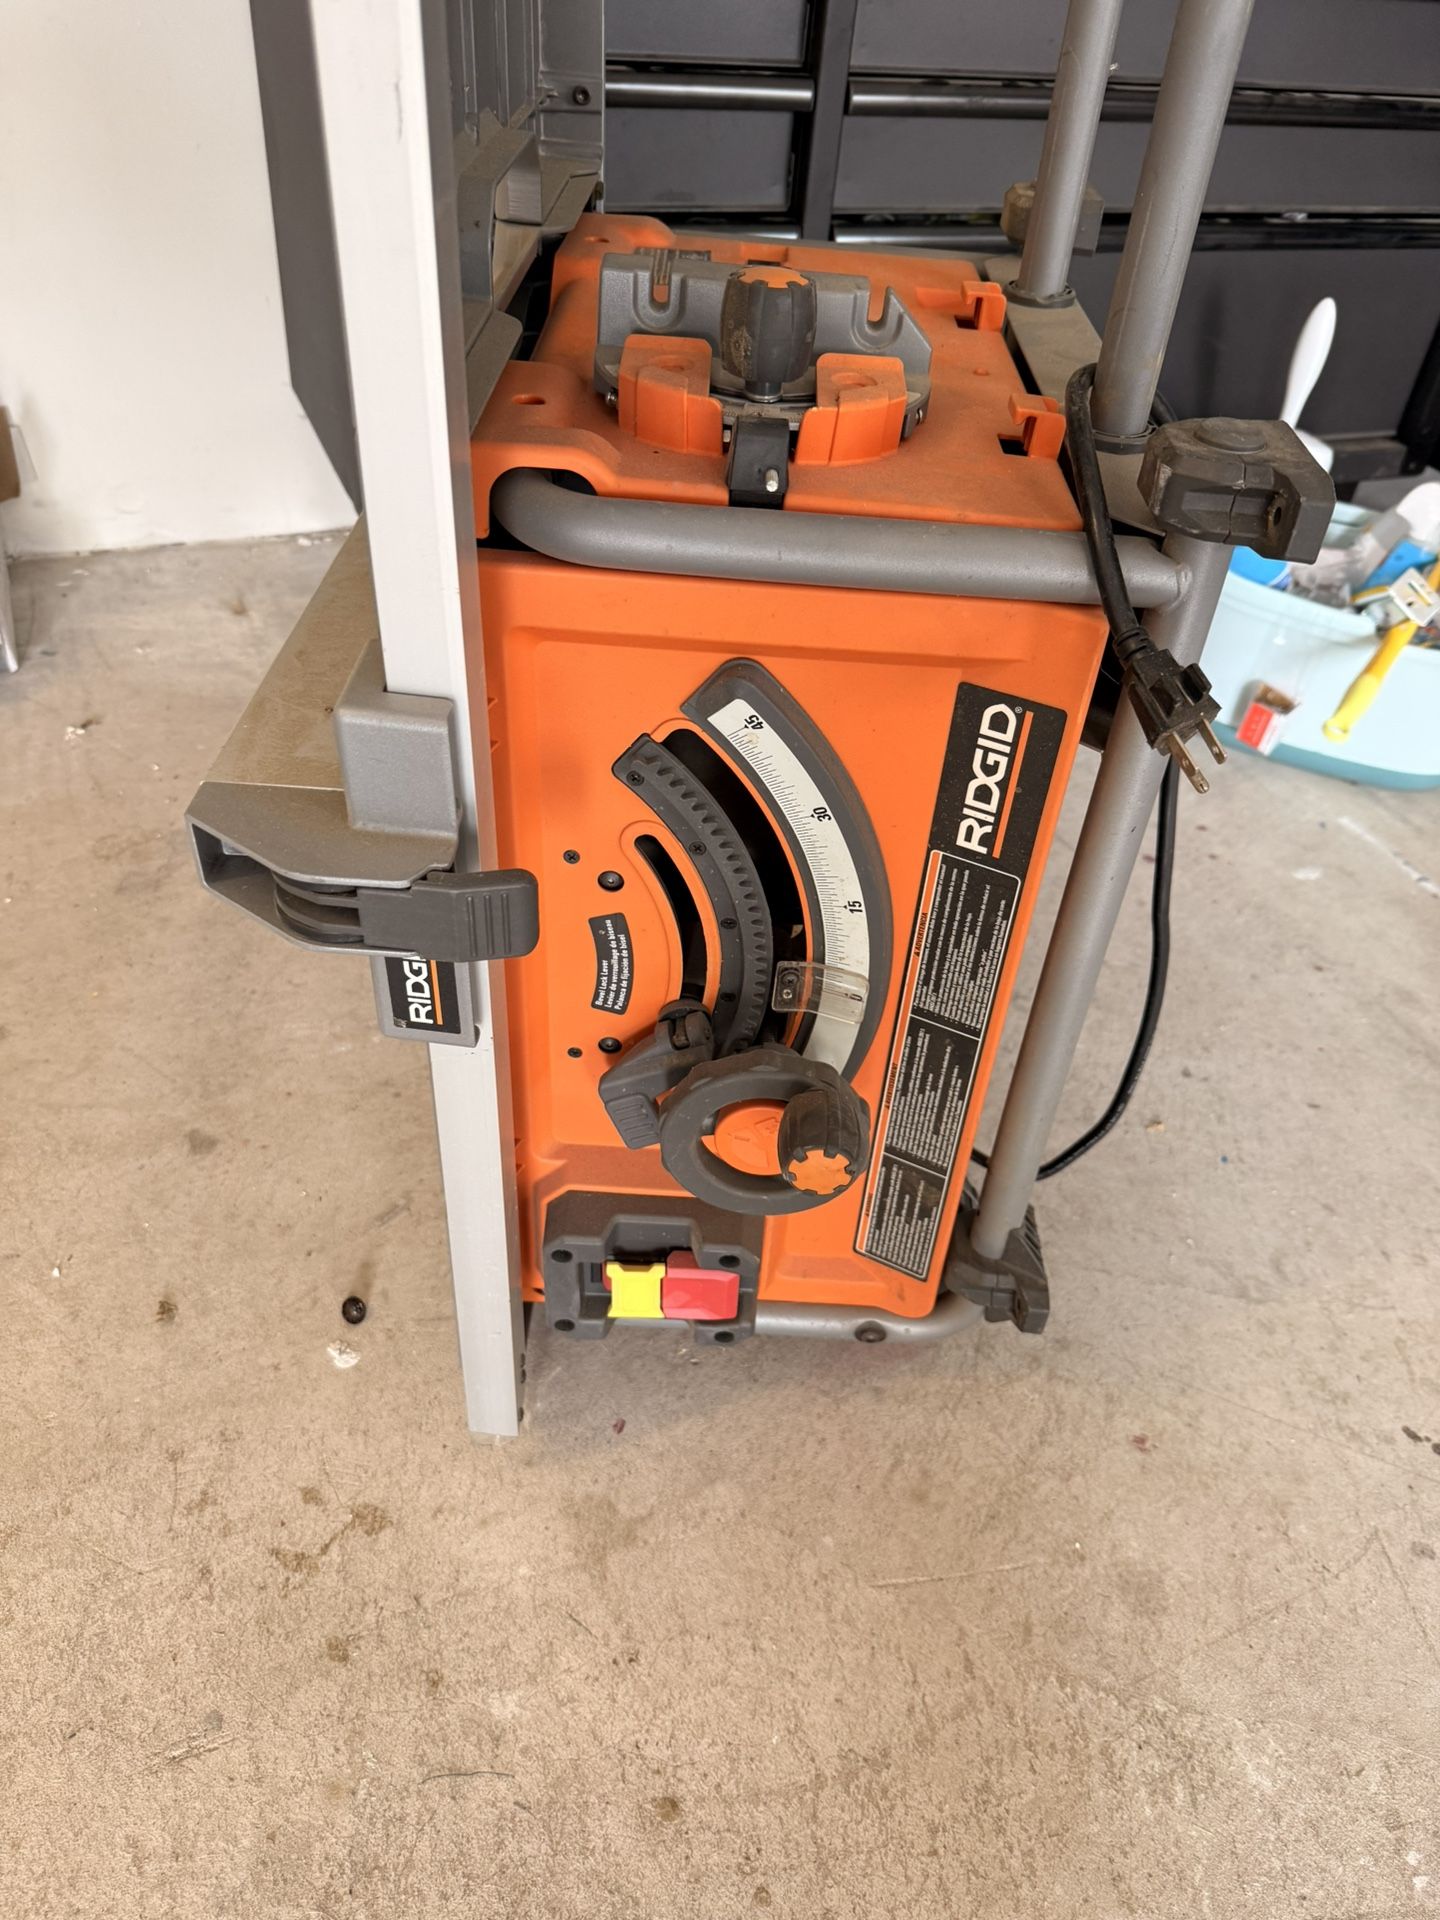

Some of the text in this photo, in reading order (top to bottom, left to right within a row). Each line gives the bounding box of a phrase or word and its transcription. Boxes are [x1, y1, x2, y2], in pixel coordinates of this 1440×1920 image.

[744, 714, 764, 730] 45
[813, 806, 832, 822] 30
[848, 900, 863, 914] 15
[605, 919, 616, 939] biseau
[915, 912, 928, 951] ADVERTENCIA
[617, 934, 628, 949] bisel
[599, 976, 608, 990] Lock
[595, 990, 605, 1006] Bevel
[604, 991, 615, 1008] Levier
[614, 988, 627, 1010] Palanca
